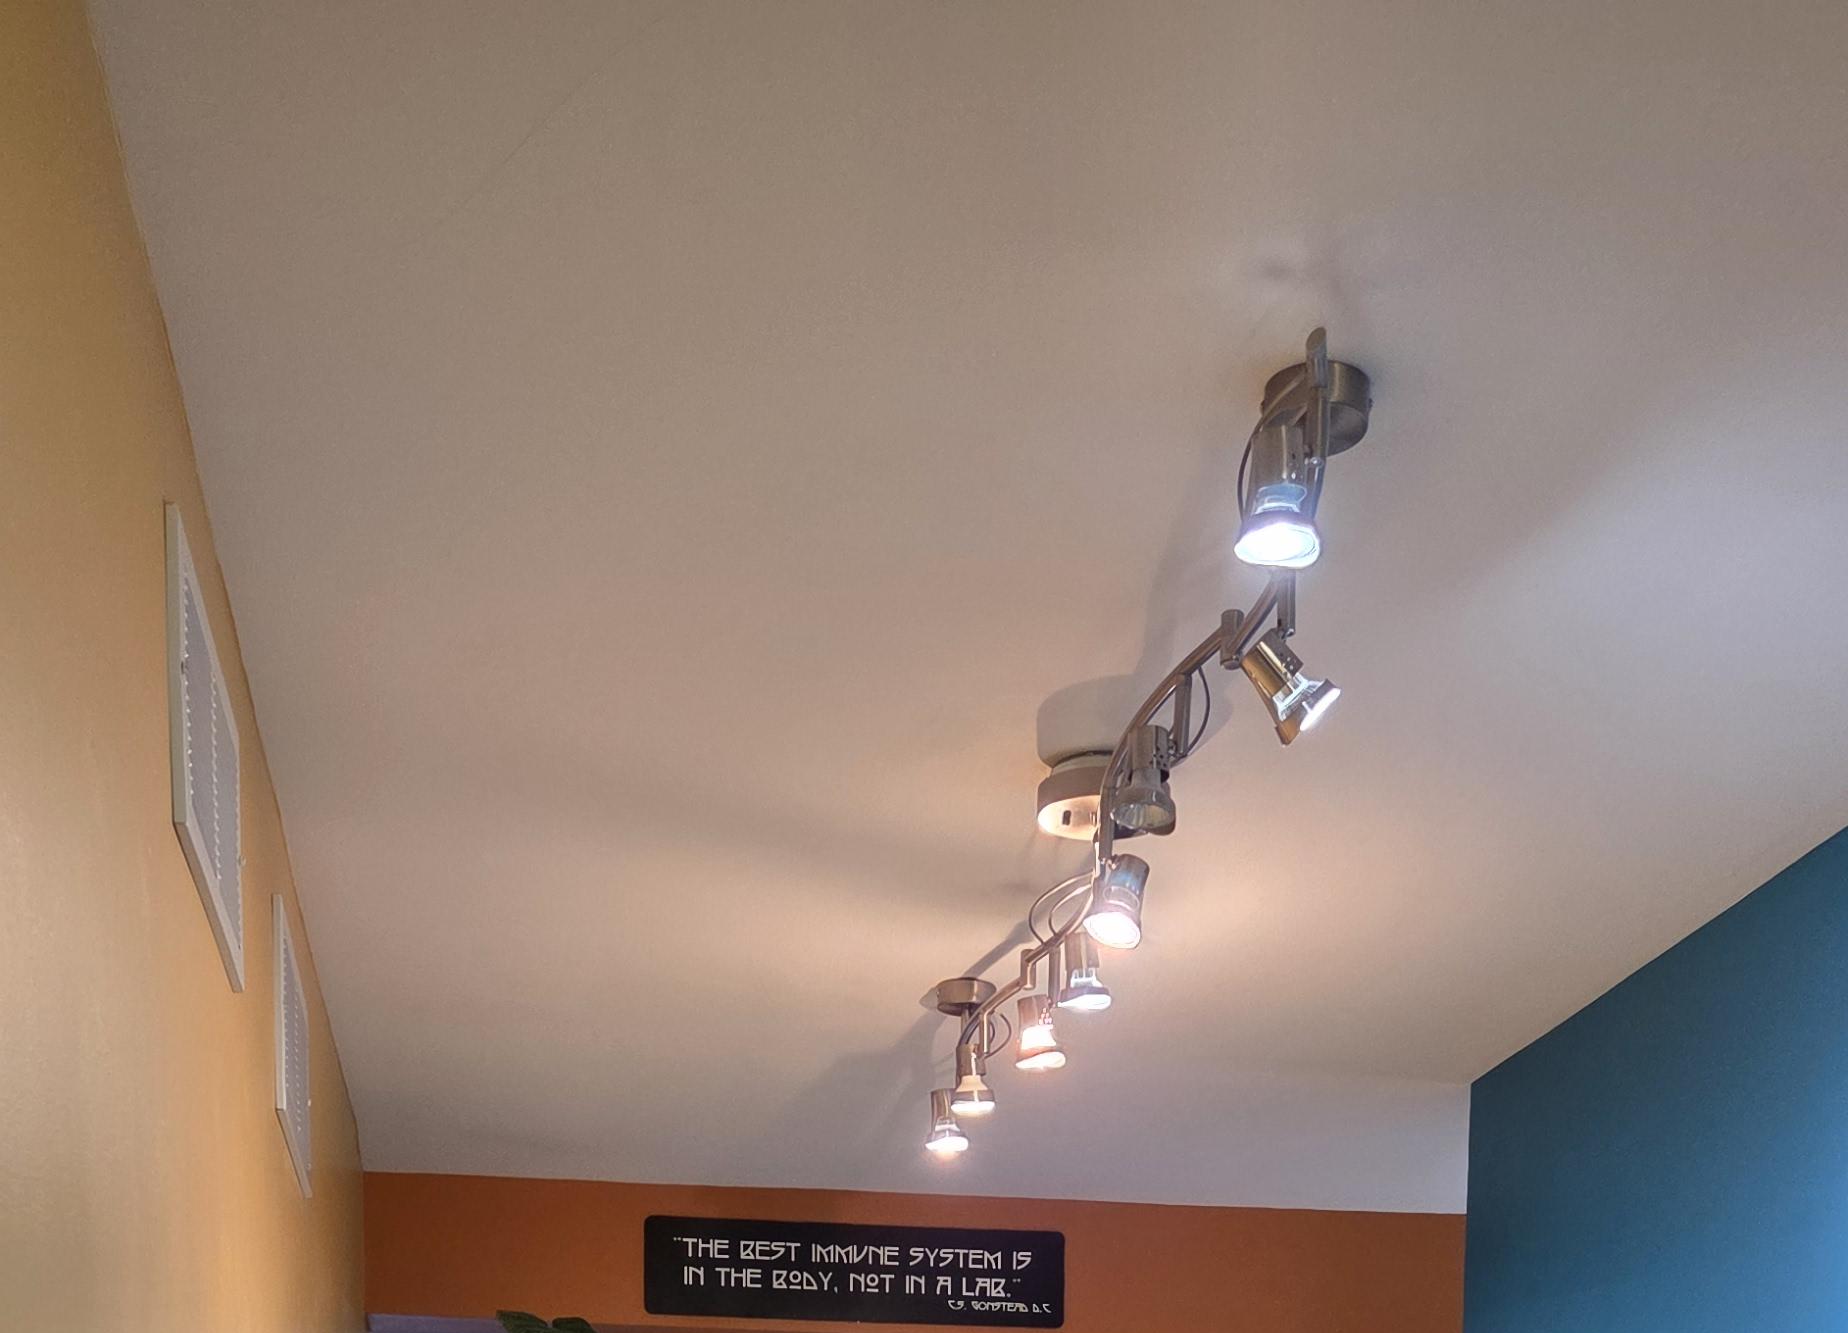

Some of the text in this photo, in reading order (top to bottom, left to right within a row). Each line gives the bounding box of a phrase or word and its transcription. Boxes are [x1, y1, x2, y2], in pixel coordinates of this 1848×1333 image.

[740, 1240, 801, 1261] BEST
[909, 1247, 1002, 1270] SYSTEM
[1012, 1251, 1032, 1271] IS
[683, 1265, 705, 1286] IN
[715, 1267, 762, 1288] THE
[772, 1269, 839, 1294] BODY,
[849, 1272, 895, 1294] NOT
[905, 1275, 926, 1295] IN
[936, 1276, 952, 1296] A
